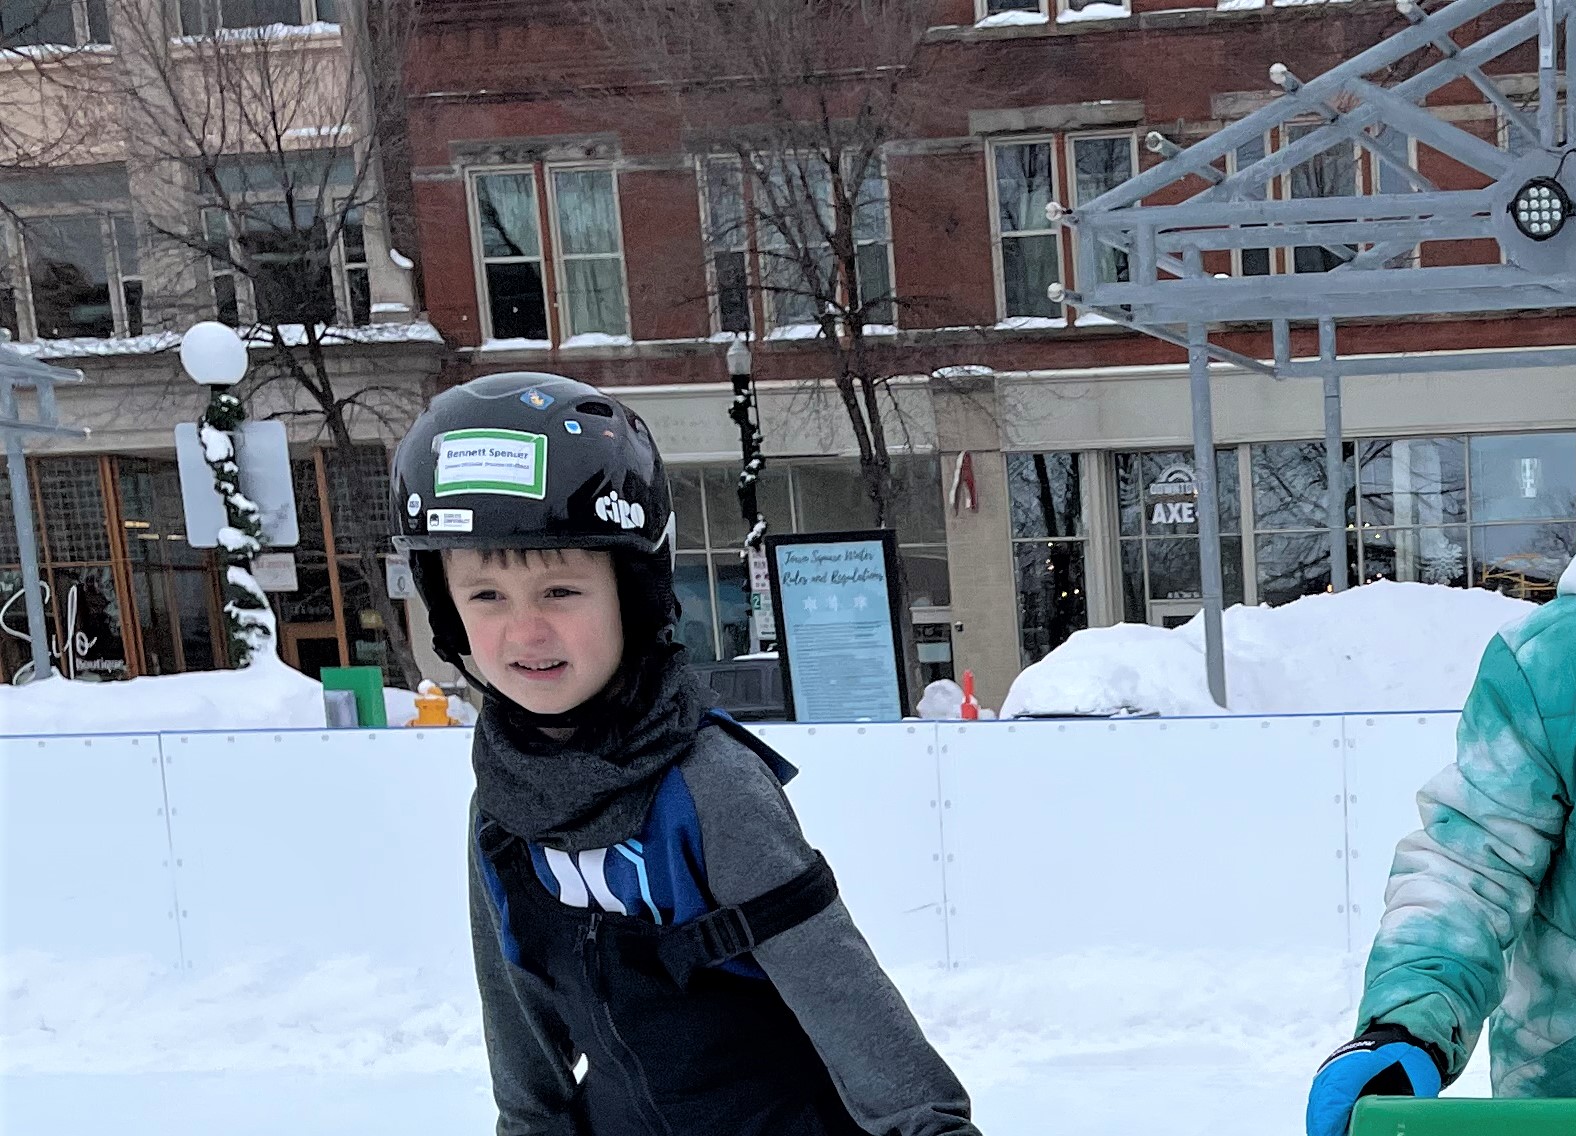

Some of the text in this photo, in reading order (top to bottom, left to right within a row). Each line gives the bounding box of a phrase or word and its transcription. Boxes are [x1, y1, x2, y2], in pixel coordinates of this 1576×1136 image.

[446, 449, 487, 459] Bennett
[1152, 502, 1195, 523] AXE
[810, 550, 842, 566] Square
[782, 570, 808, 587] Rules
[810, 571, 828, 584] and
[831, 567, 884, 587] Regulations
